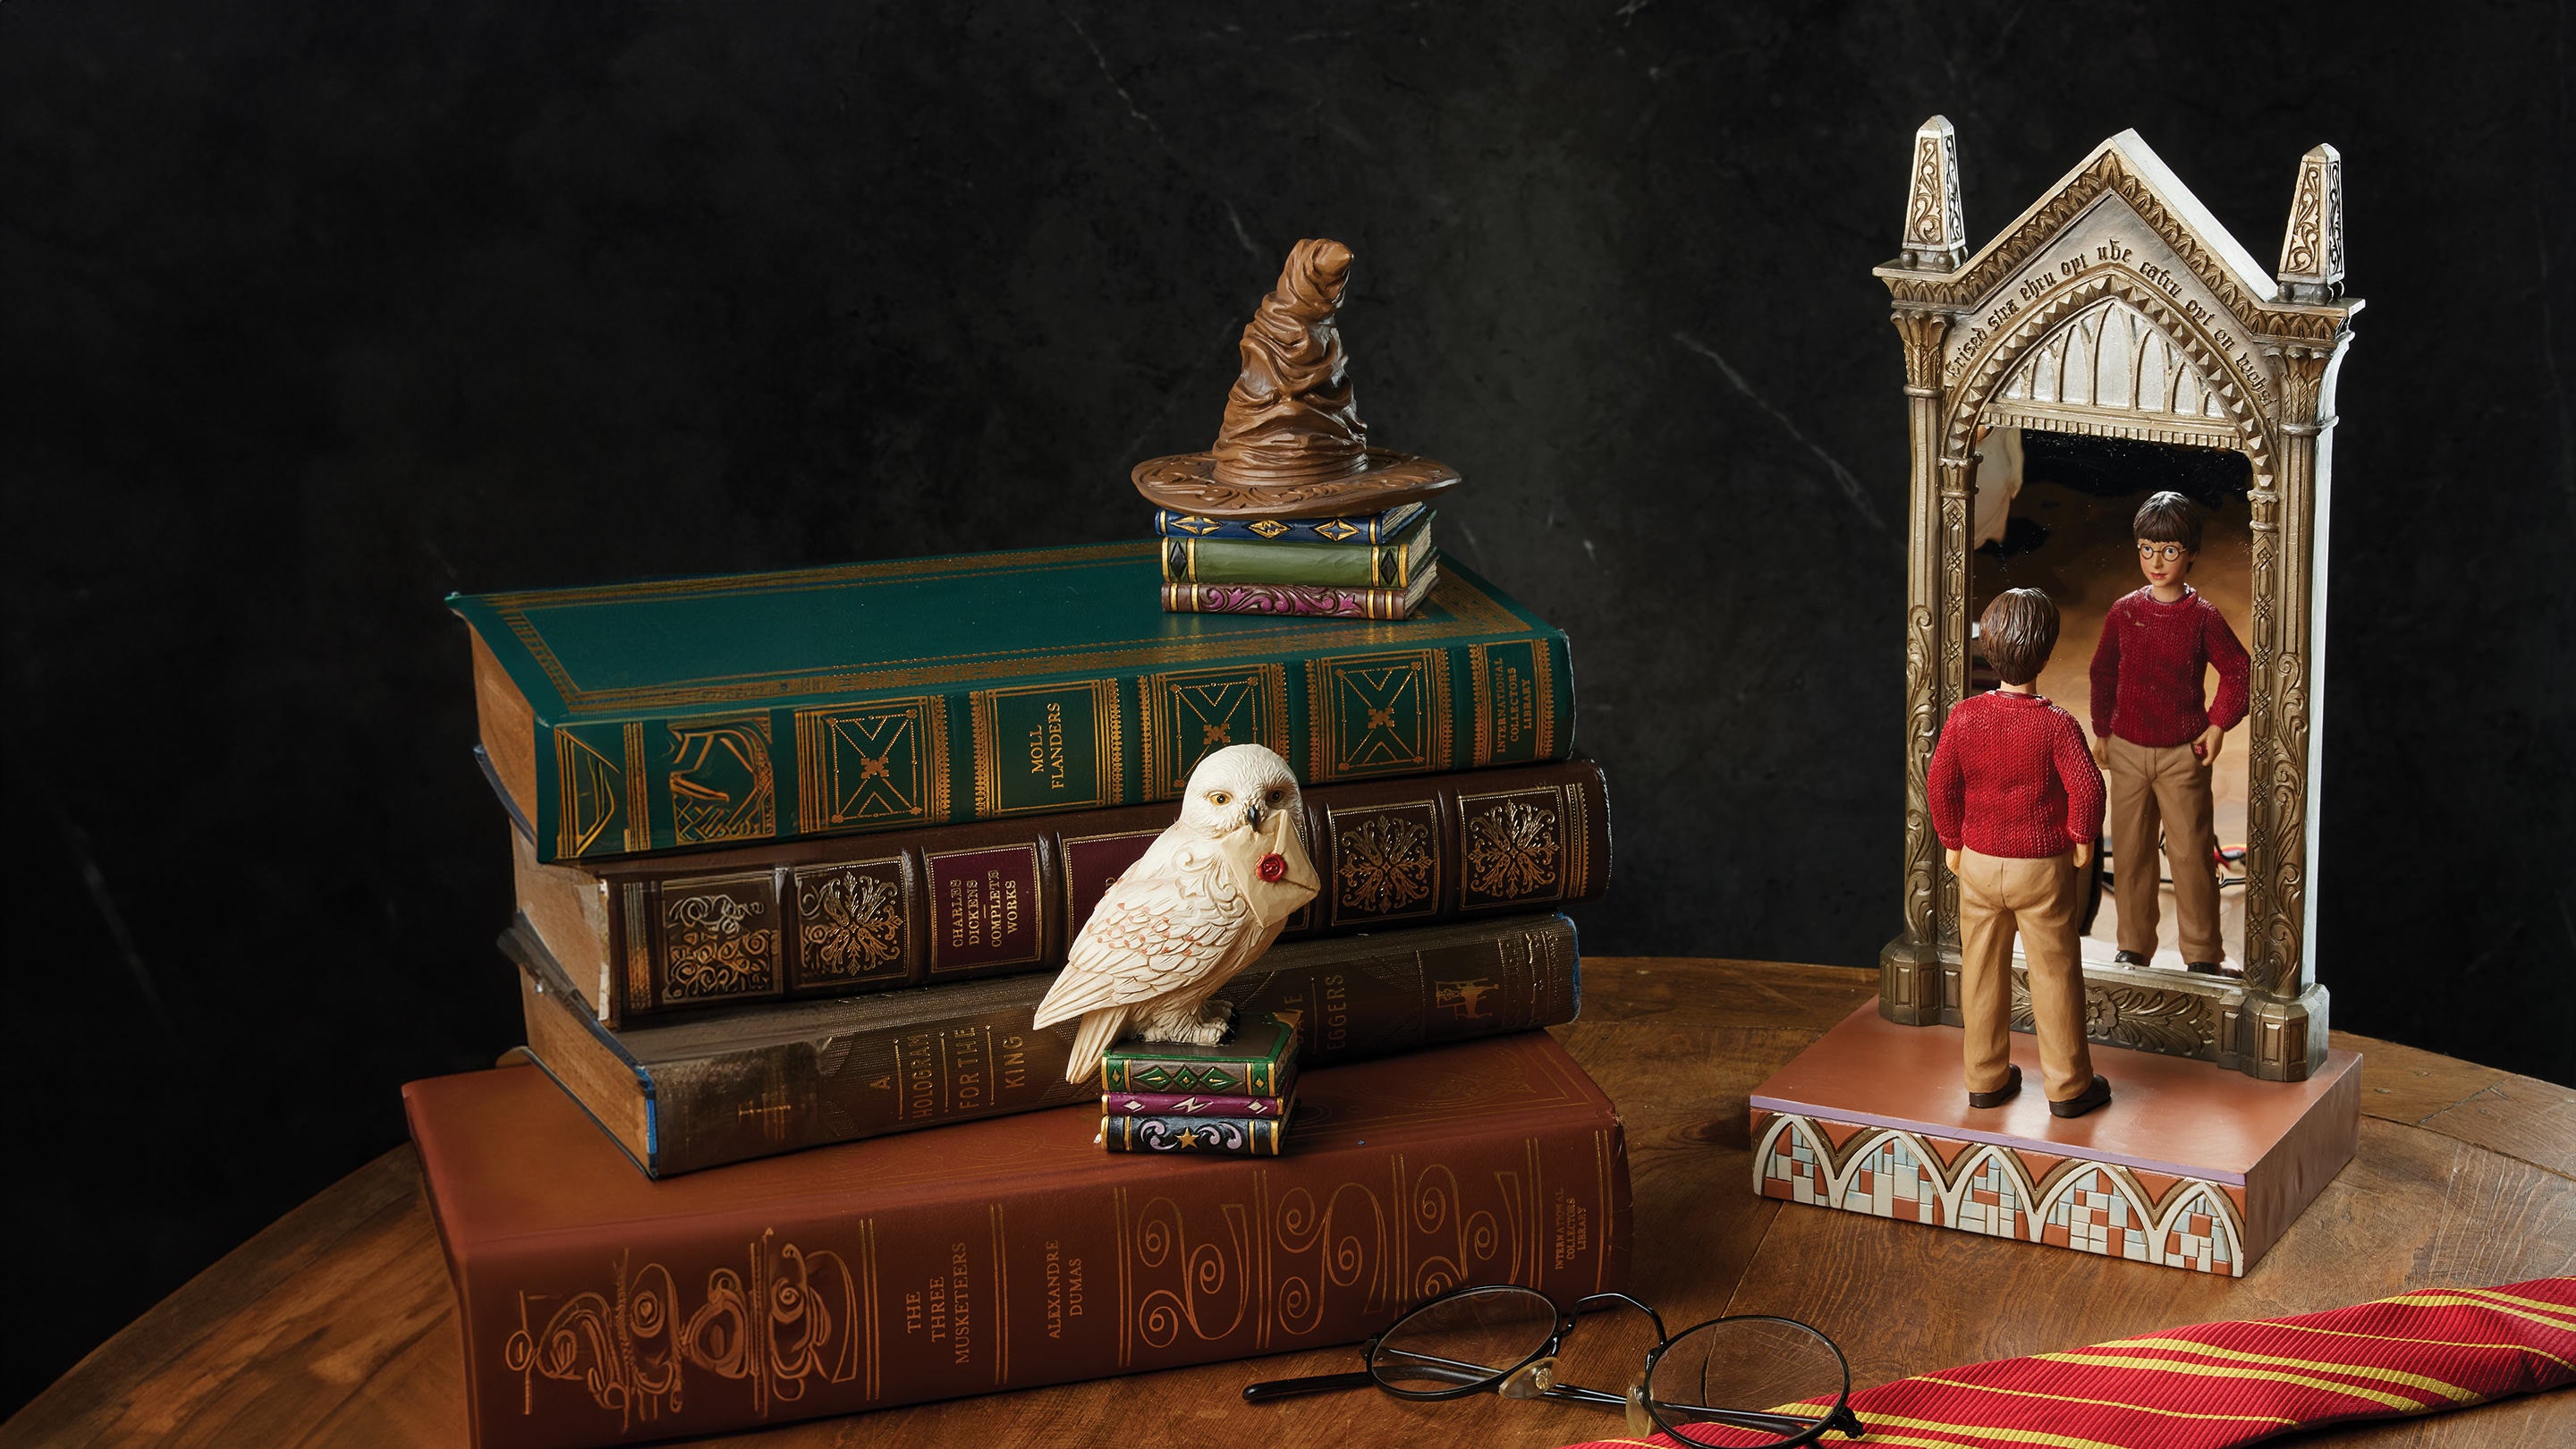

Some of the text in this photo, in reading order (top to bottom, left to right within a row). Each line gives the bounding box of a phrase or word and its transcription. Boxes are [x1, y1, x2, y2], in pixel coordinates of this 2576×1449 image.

[1945, 327, 1988, 378] Erised
[1987, 299, 2021, 332] stra
[2020, 271, 2058, 301] ehru
[2097, 239, 2133, 264] ube
[2214, 327, 2236, 352] on
[1494, 657, 1506, 753] INTERNATIONAL
[1507, 667, 1519, 742] COLLECTORS
[1521, 679, 1532, 730] LIBRARY
[1030, 724, 1045, 774] MOLL
[1046, 702, 1064, 790] FLANDERS
[950, 879, 963, 948] CHARLES
[967, 879, 980, 945] DICKENS
[987, 869, 1002, 948] COMPLETE
[1004, 879, 1018, 935] WORKS
[1325, 974, 1346, 1050] EGGERS
[869, 1074, 891, 1089] A
[908, 1033, 933, 1119] HOLOGRAM
[954, 1027, 979, 1109] FOR THE
[1002, 1036, 1025, 1089] KING
[1555, 1187, 1564, 1270] INTERNATIONAL
[1566, 1198, 1576, 1260] COLLECTORS
[1577, 1206, 1587, 1250] LIBRARY
[906, 1291, 921, 1334] THE
[930, 1276, 945, 1343] THREE
[952, 1241, 970, 1364] MUSKETEERS
[1046, 1239, 1061, 1339] ALEXANDRE
[1069, 1258, 1083, 1317] DUMAS
